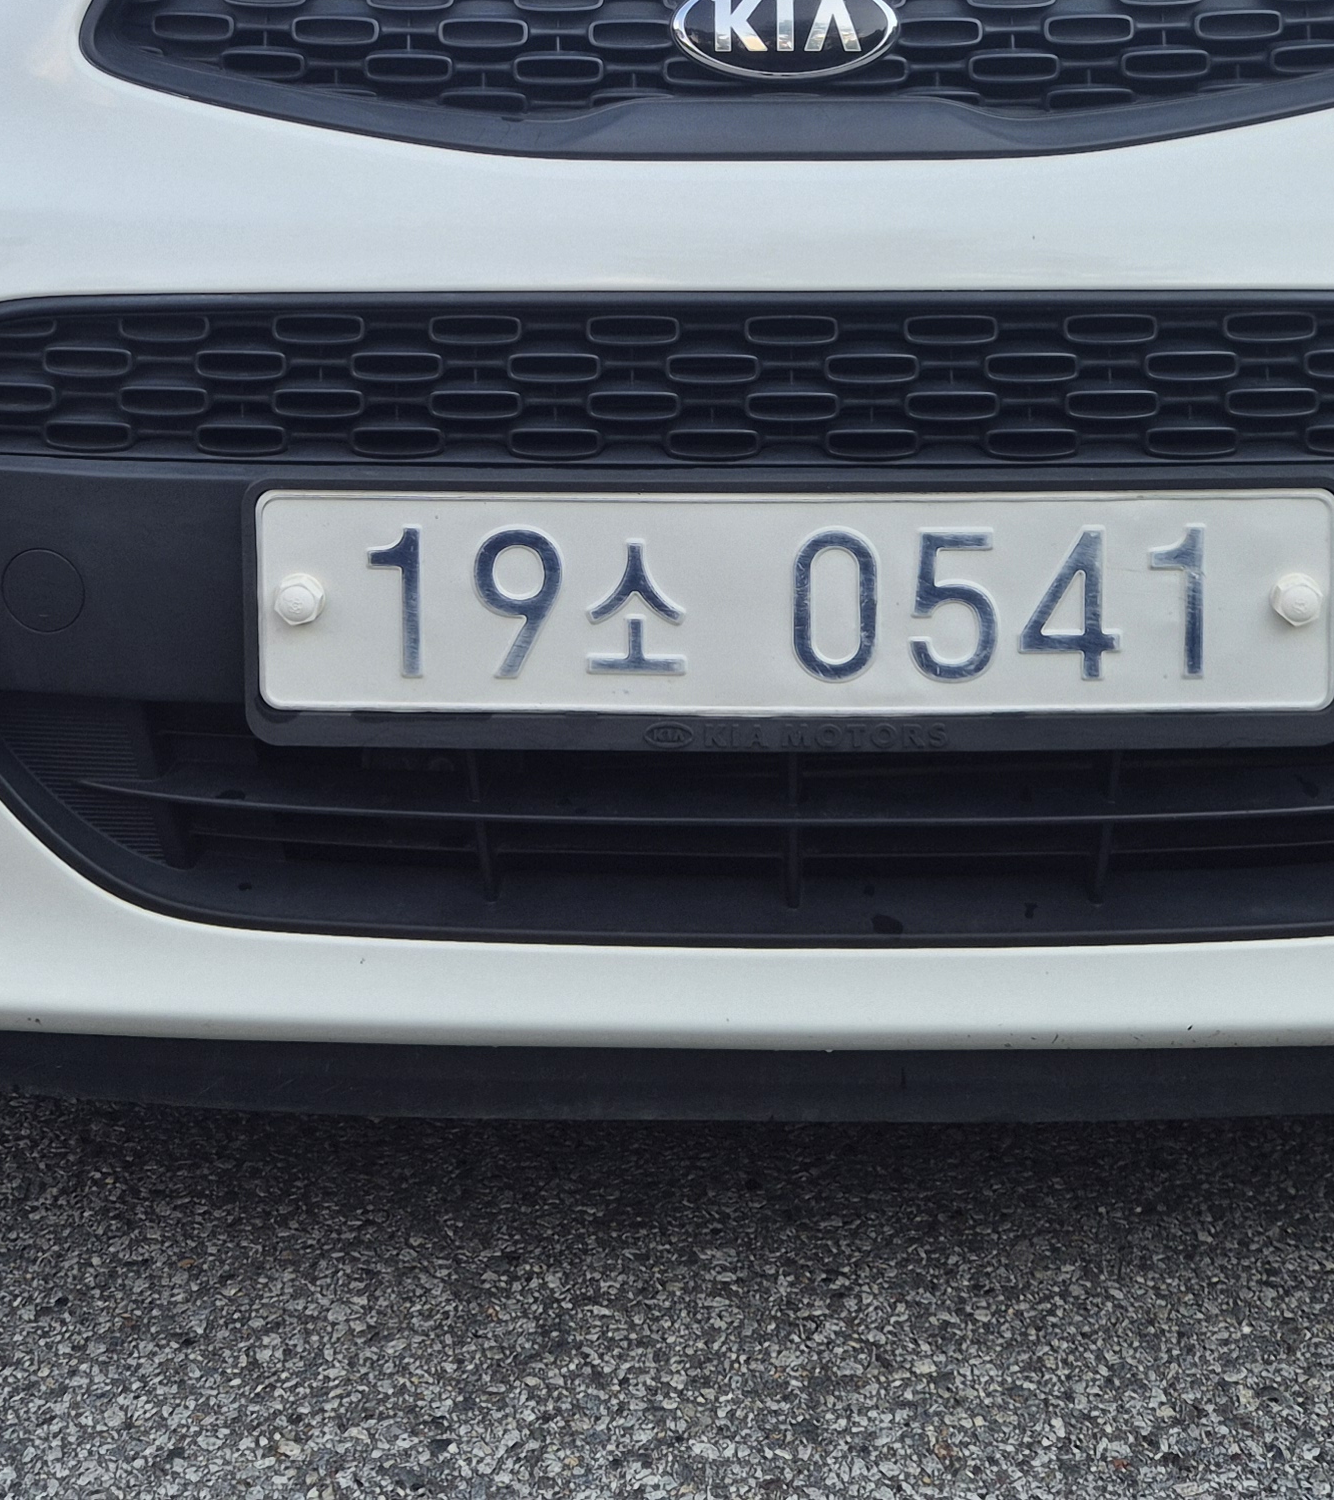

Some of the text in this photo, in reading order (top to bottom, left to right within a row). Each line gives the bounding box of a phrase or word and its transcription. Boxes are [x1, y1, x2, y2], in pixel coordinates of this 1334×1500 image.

[367, 522, 1208, 684] 19소 0541
[653, 722, 951, 749] KIA KIA MOTORS
